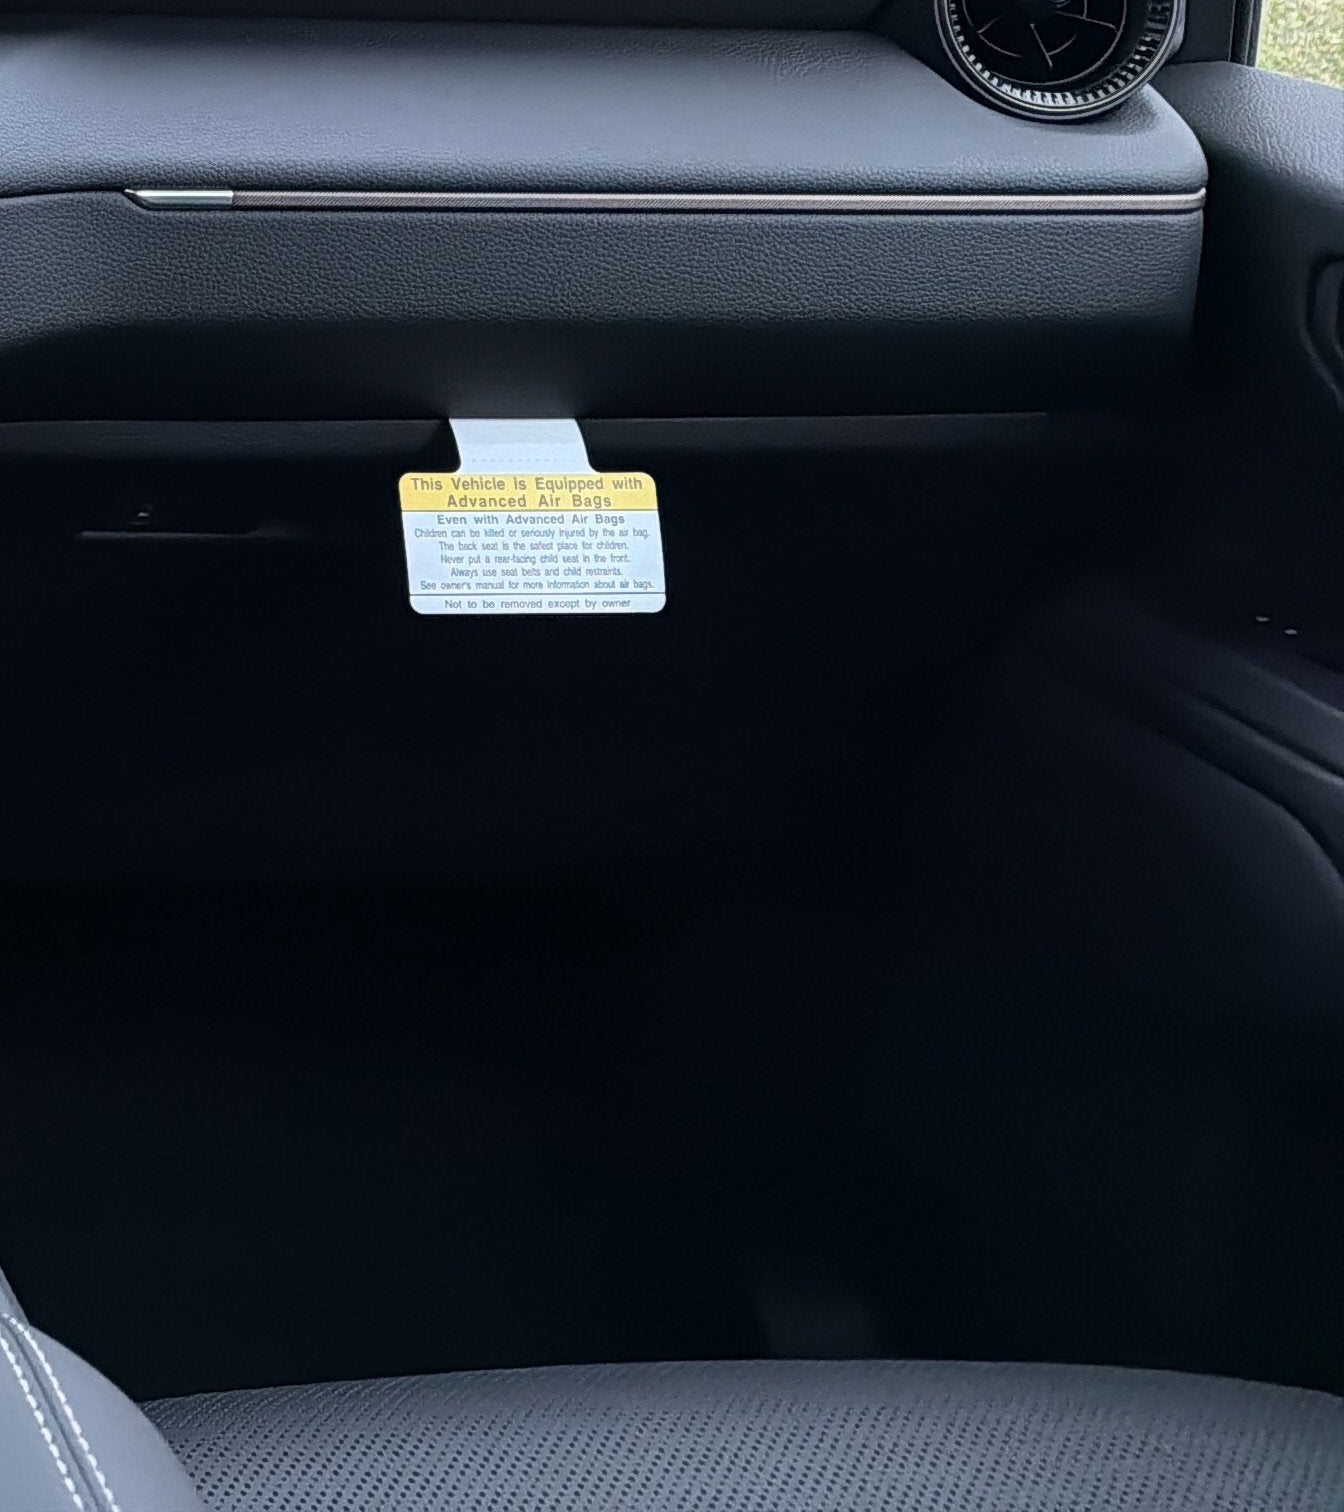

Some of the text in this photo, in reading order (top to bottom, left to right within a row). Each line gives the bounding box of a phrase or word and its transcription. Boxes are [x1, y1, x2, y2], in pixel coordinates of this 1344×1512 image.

[411, 477, 643, 493] This Vehicle is Equipped with
[447, 494, 612, 509] Advanced Air Bags
[437, 514, 625, 526] Even with Advanced Air Bags
[414, 529, 447, 538] Children
[451, 530, 466, 538] can
[469, 529, 480, 537] be
[484, 529, 505, 537] killed
[589, 529, 598, 538] by
[603, 529, 615, 537] the
[632, 528, 650, 539] bag.
[439, 541, 629, 551] The back seat is the safest place for children.
[440, 555, 464, 563] Never
[468, 555, 481, 566] put
[540, 554, 558, 563] child
[583, 554, 590, 563] in
[594, 554, 606, 563] the
[451, 568, 478, 579] Always
[501, 568, 518, 576] seat
[522, 567, 541, 576] belts
[544, 568, 559, 576] and
[563, 568, 581, 576] child
[420, 581, 437, 590] See
[440, 581, 471, 590] owner's
[475, 581, 505, 589] manual
[508, 580, 519, 589] for
[547, 580, 589, 589] information
[594, 580, 616, 588] about
[620, 579, 629, 588] air
[633, 579, 655, 590] bags.
[444, 600, 462, 608] Not
[468, 600, 477, 608] to
[482, 600, 496, 608] be
[500, 599, 543, 609] removed
[548, 600, 580, 609] except
[585, 599, 597, 609] by
